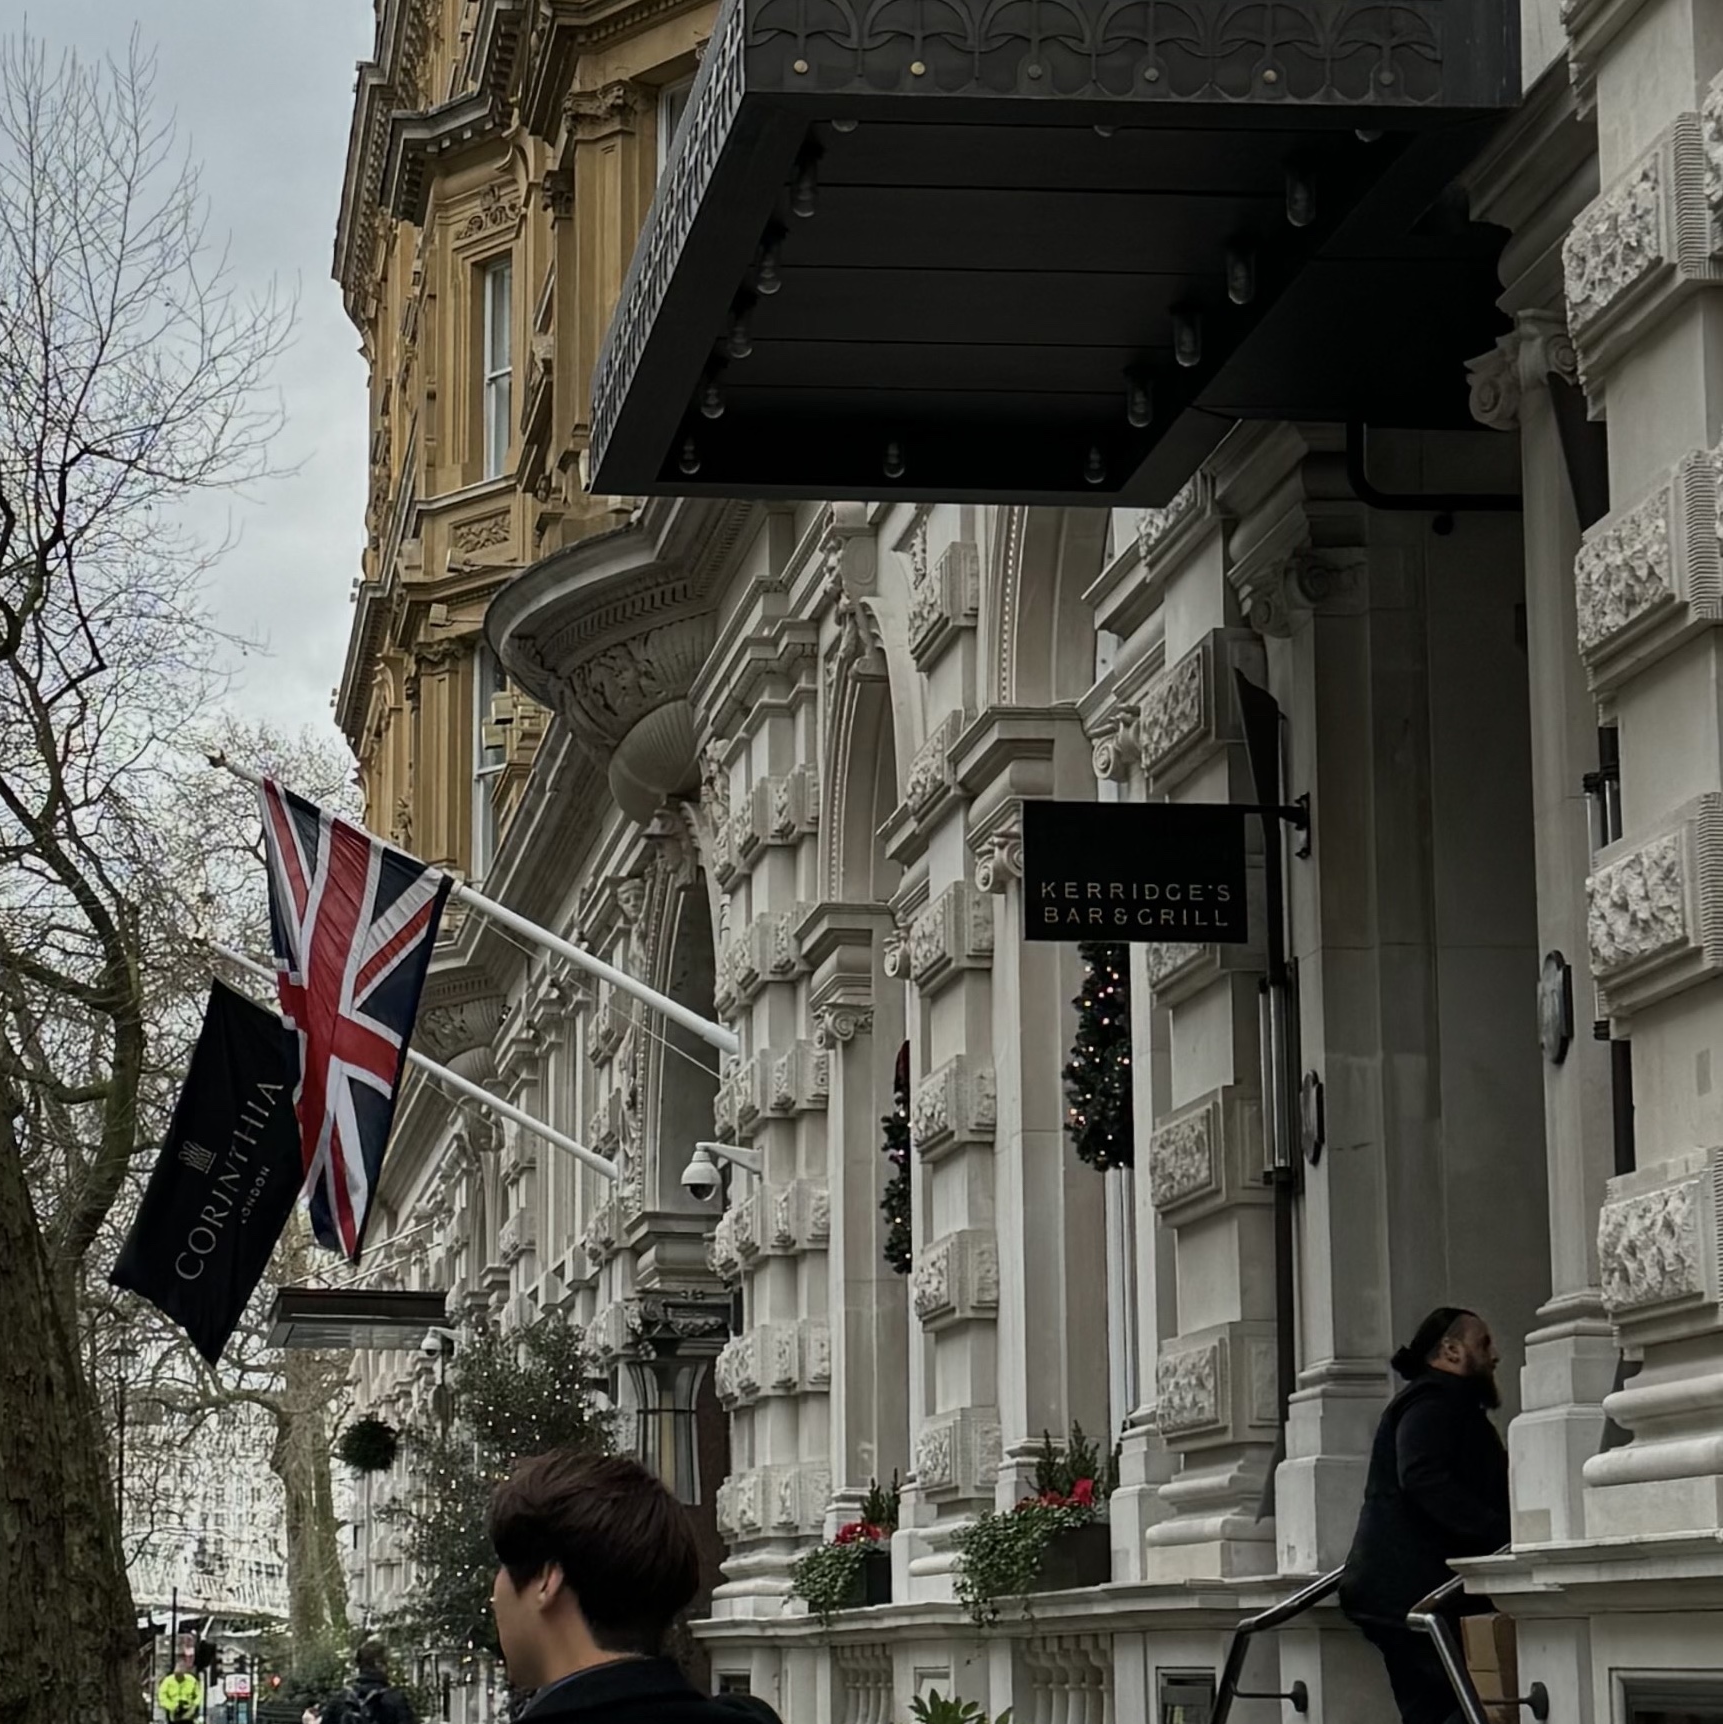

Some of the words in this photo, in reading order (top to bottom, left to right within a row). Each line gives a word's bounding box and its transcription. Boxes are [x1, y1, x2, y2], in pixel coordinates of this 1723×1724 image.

[1041, 881, 1231, 902] KERRIDGE'S
[175, 1083, 284, 1280] CORINTHIA
[241, 1166, 271, 1224] ONDON
